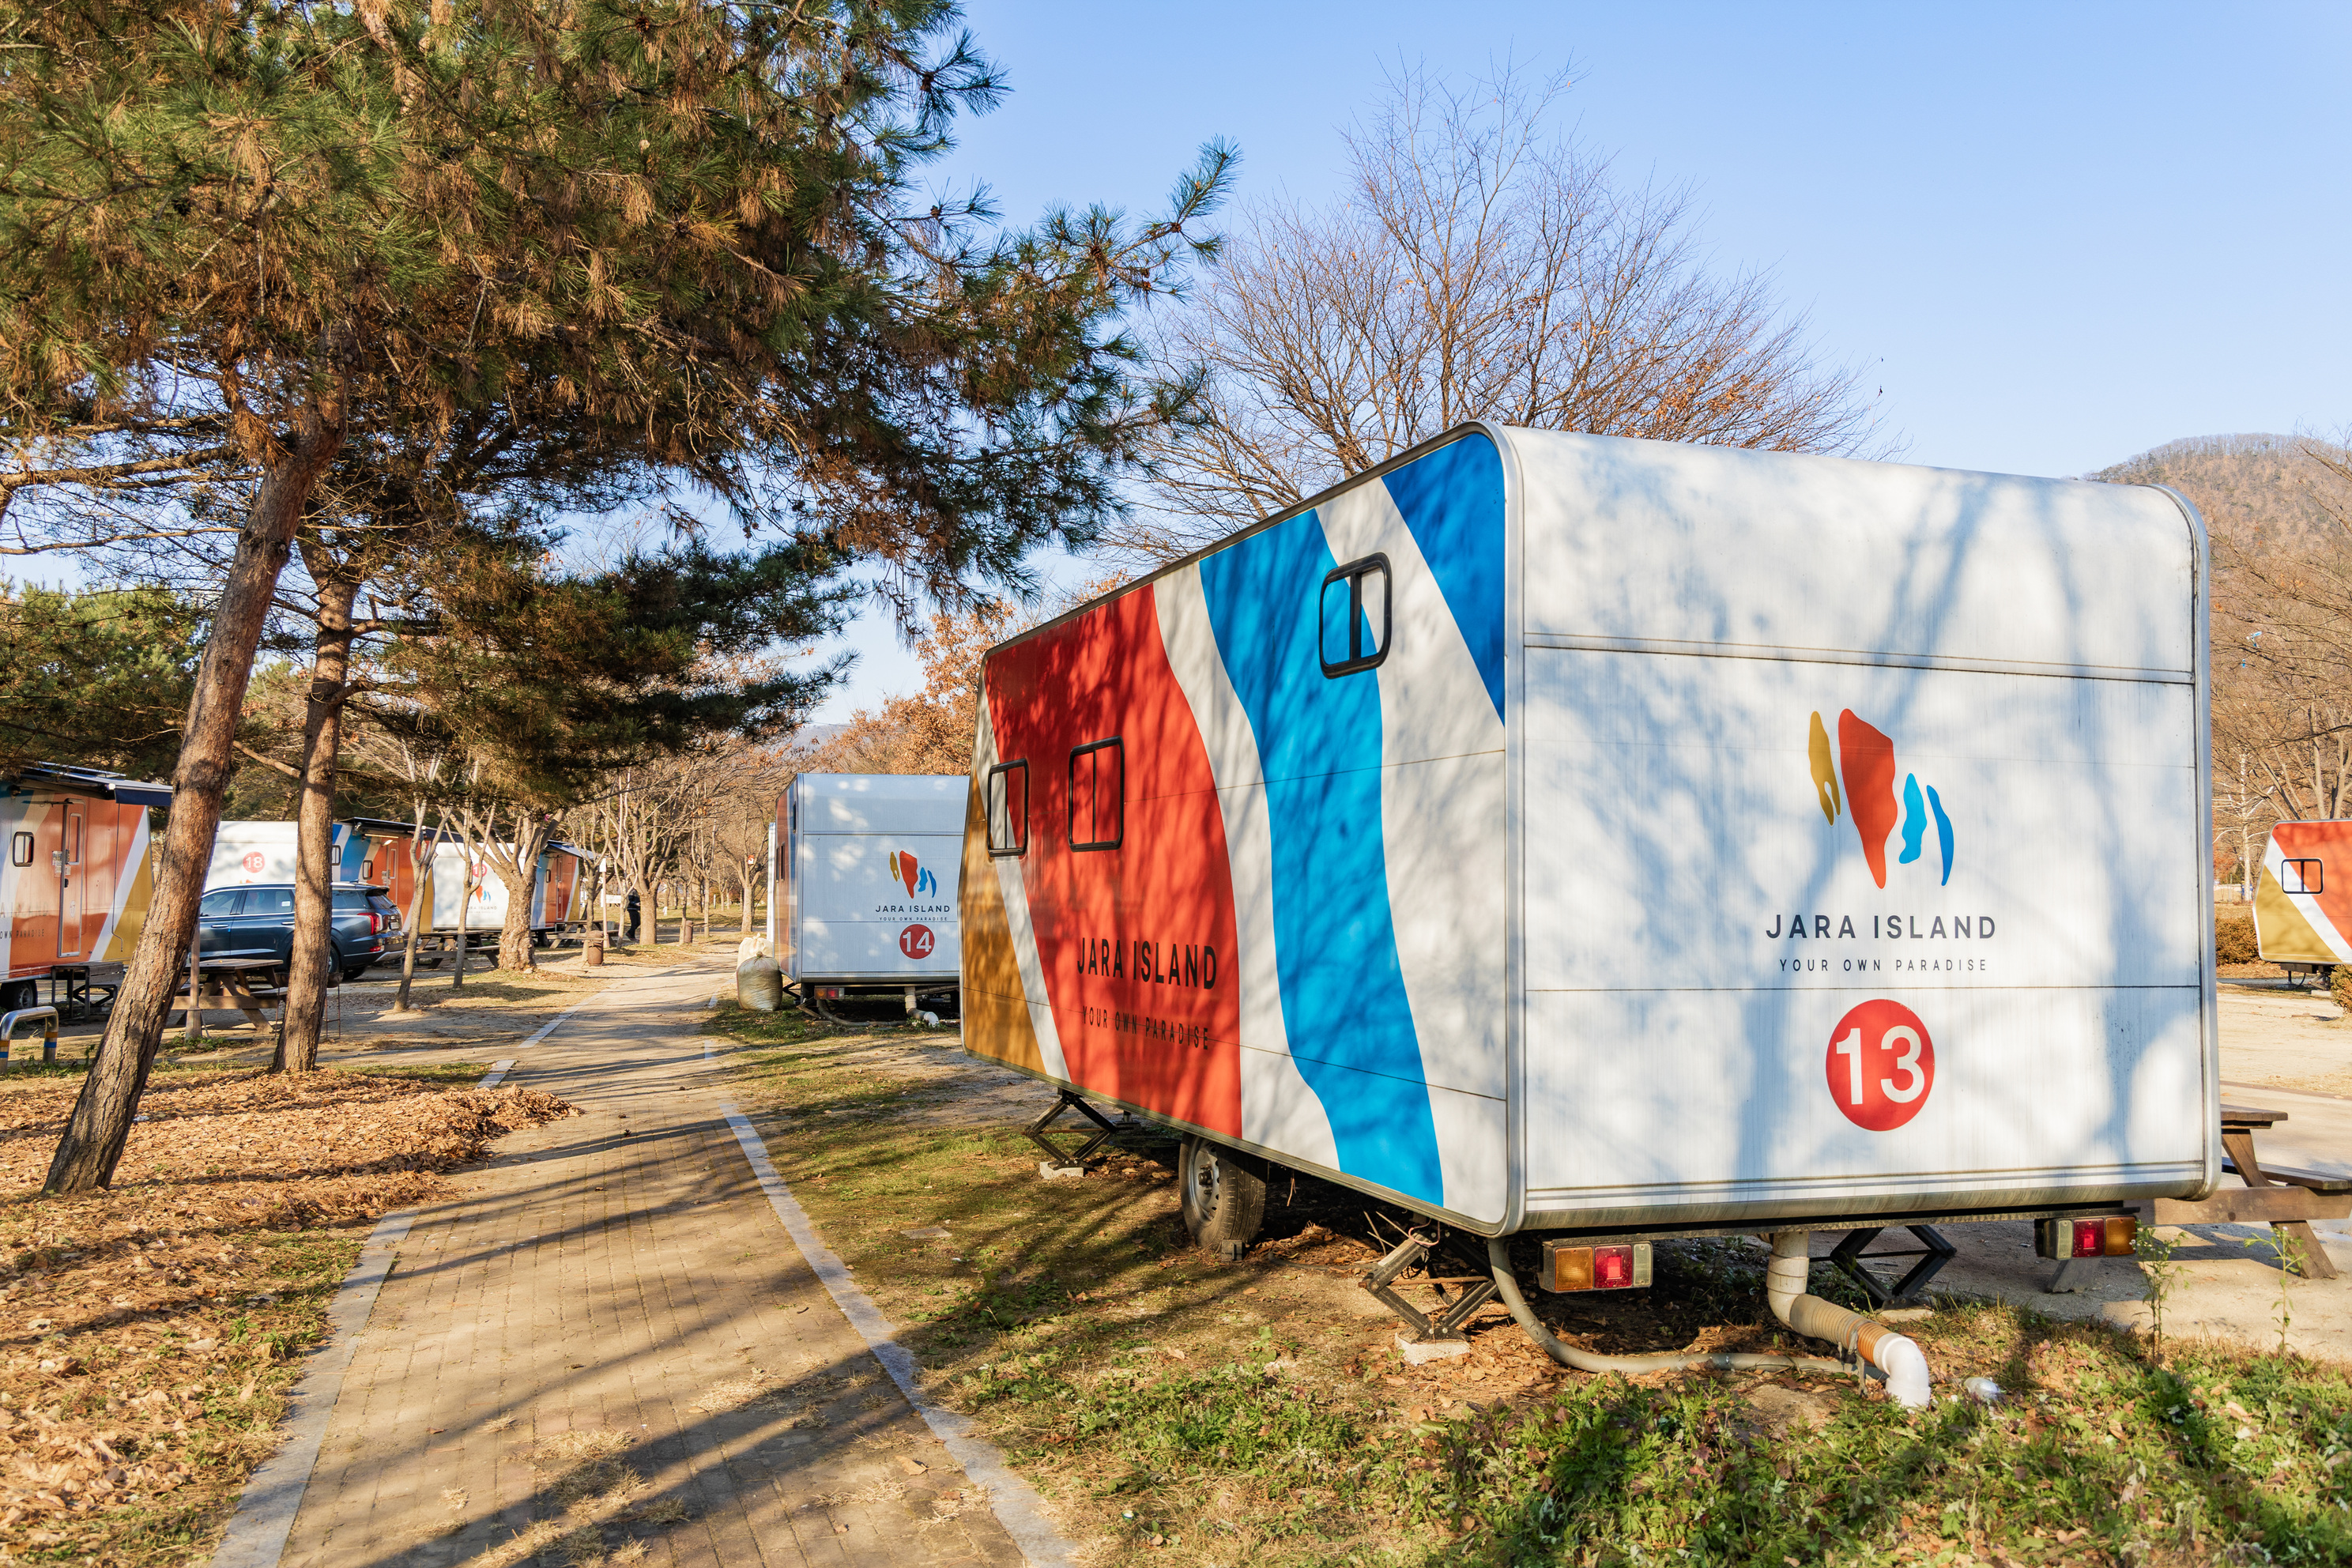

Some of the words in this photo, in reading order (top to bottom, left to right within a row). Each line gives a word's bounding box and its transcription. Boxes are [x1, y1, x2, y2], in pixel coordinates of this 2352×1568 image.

[246, 856, 263, 869] 18
[1766, 914, 1856, 939] JARA
[1874, 915, 1996, 939] ISLAND
[903, 931, 932, 952] 14
[1077, 937, 1123, 978] JARA
[1133, 940, 1217, 989] ISLAND
[1780, 959, 1829, 971] YOUR
[1843, 959, 1880, 971] OWN
[1896, 959, 1986, 971] PARADISE
[1083, 1005, 1107, 1028] YOUR
[1115, 1011, 1137, 1035] OWN
[1146, 1017, 1208, 1050] PARADISE
[1836, 1025, 1925, 1105] 13
